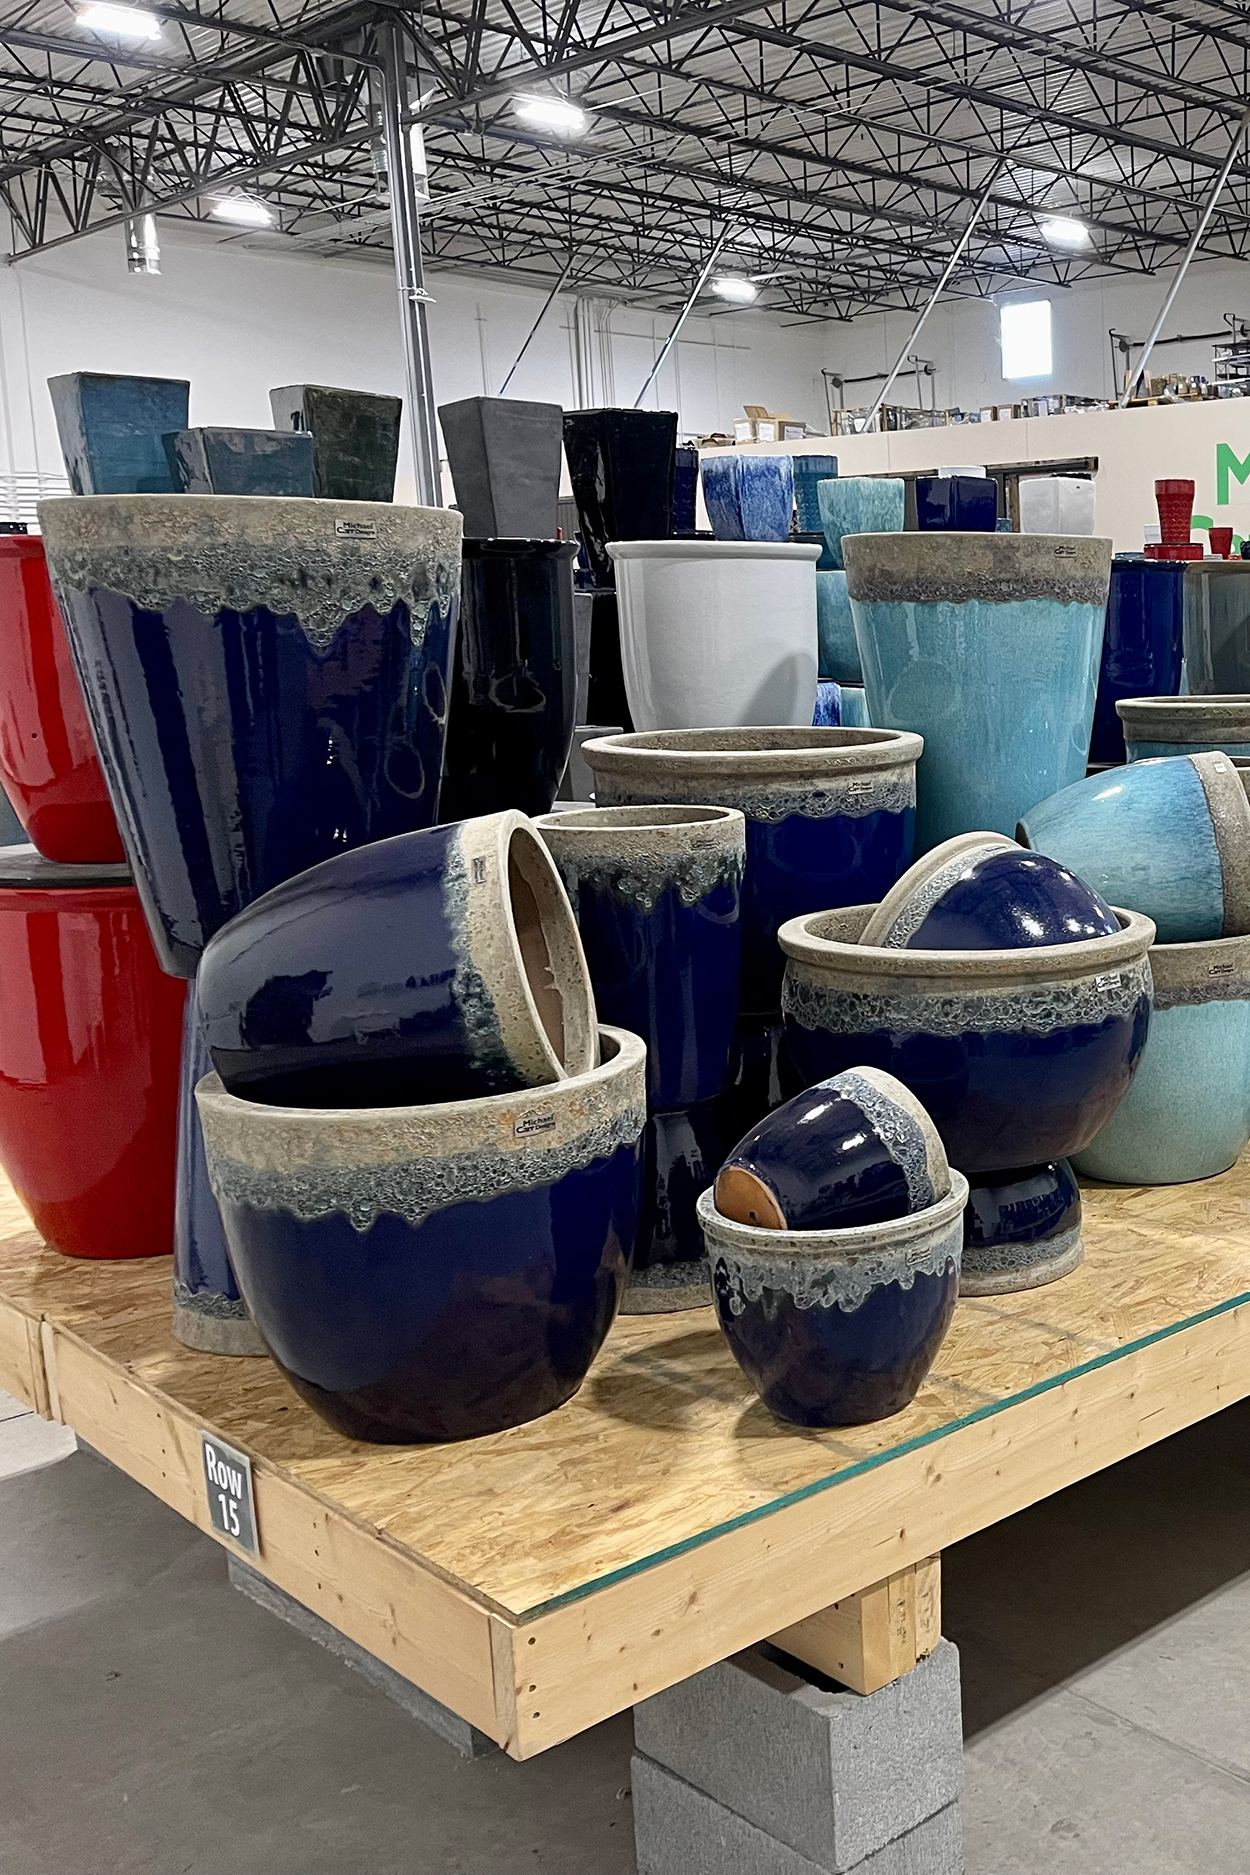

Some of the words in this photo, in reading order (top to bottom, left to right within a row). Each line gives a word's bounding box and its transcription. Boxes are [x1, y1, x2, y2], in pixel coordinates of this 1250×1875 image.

[343, 521, 373, 530] Michael
[523, 1112, 556, 1127] Michael
[516, 1125, 535, 1134] Carr
[204, 1442, 242, 1500] Row
[217, 1493, 241, 1537] 15
